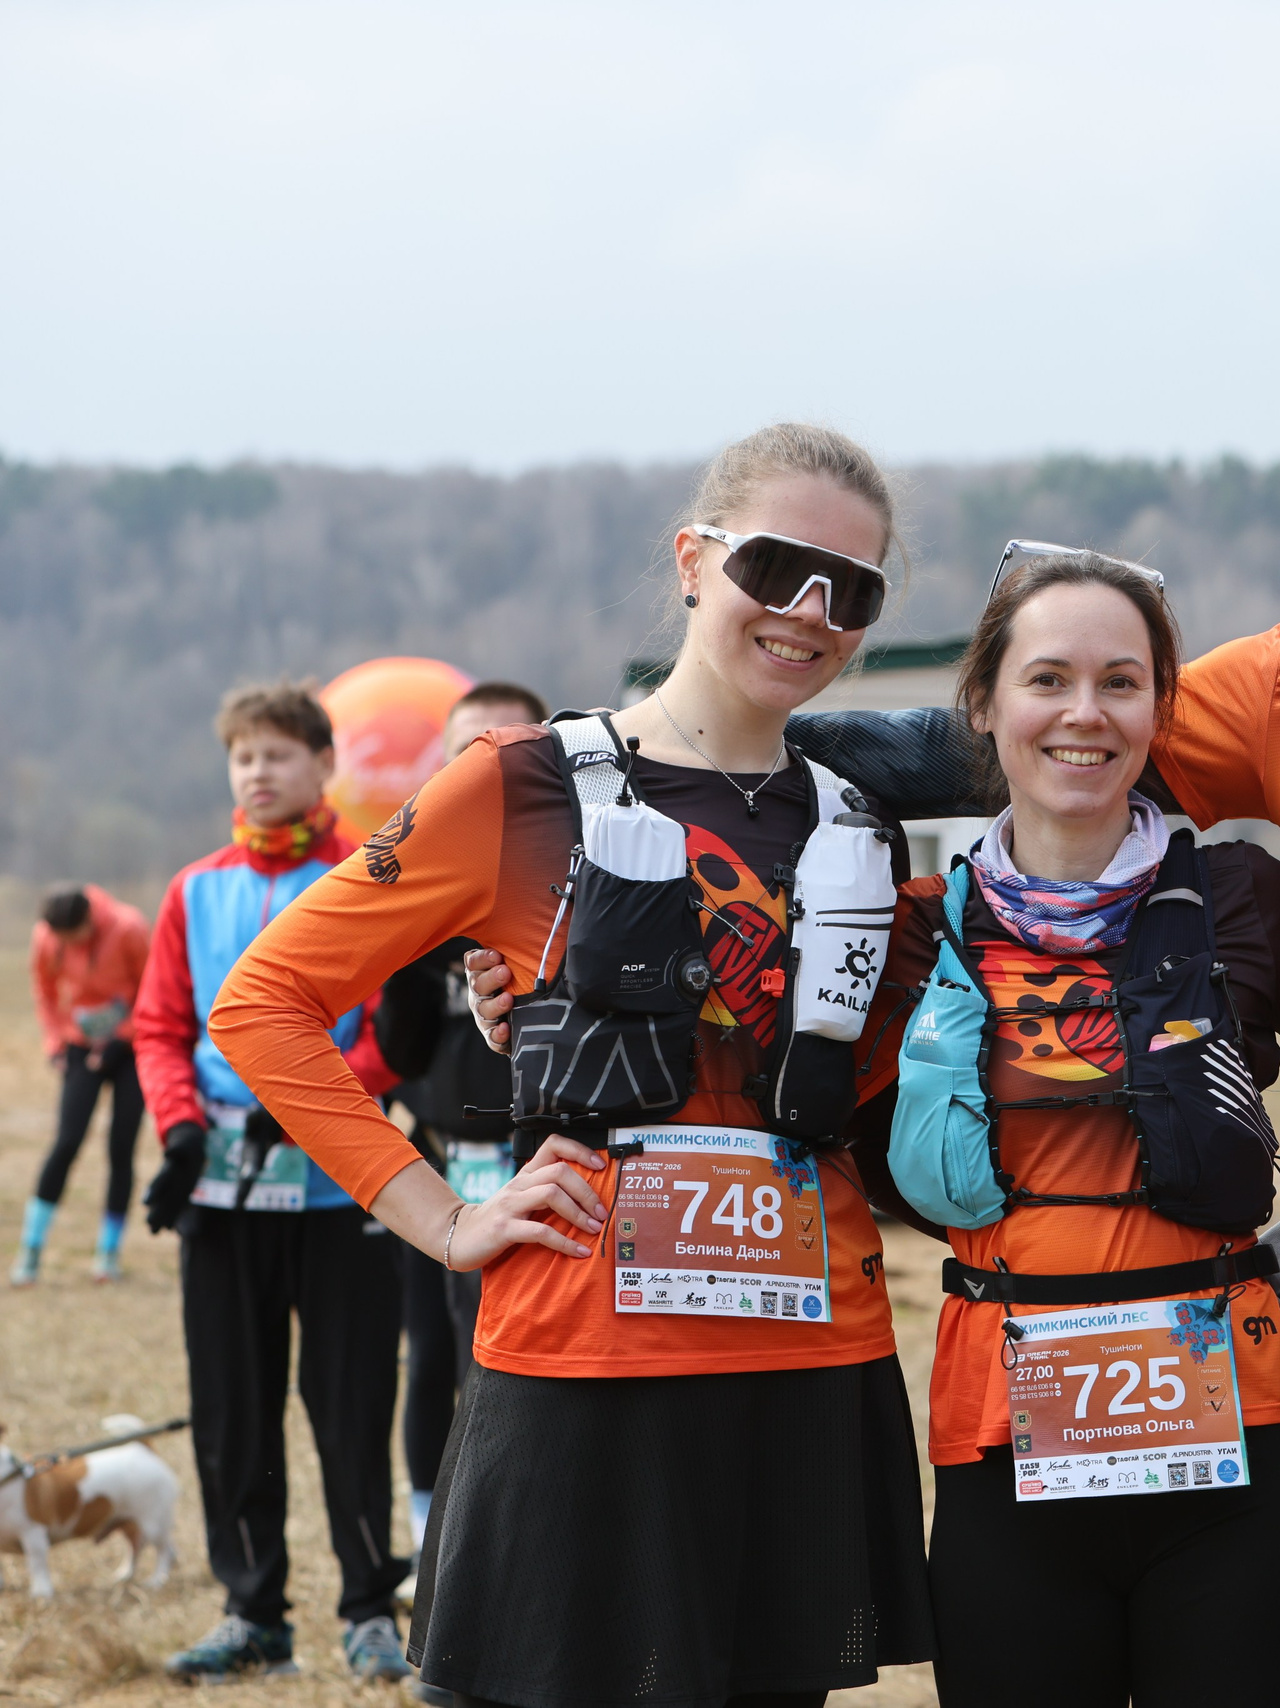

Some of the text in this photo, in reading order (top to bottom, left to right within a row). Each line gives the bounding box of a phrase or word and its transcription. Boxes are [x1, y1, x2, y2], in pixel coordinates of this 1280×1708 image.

[575, 752, 616, 767] FUGA
[621, 963, 646, 972] ADF
[632, 1133, 758, 1149] ХИМКИНСКИЙ ЛЕС
[712, 1165, 751, 1176] ТушиНоги
[624, 1176, 664, 1191] 27,00
[673, 1180, 783, 1239] 748
[675, 1241, 781, 1262] Белина Дарья
[740, 1278, 762, 1286] SCOR
[1020, 1311, 1149, 1335] ХИМКИНСКИЙ ЛЕС
[1052, 1350, 1070, 1358] 2026
[1100, 1343, 1143, 1356] ТушиНоги
[1015, 1365, 1054, 1382] 27,00
[1063, 1356, 1187, 1419] 725
[1063, 1419, 1195, 1443] Портнова Ольга
[1143, 1453, 1167, 1461] SCOR
[1020, 1462, 1040, 1470] EASY
